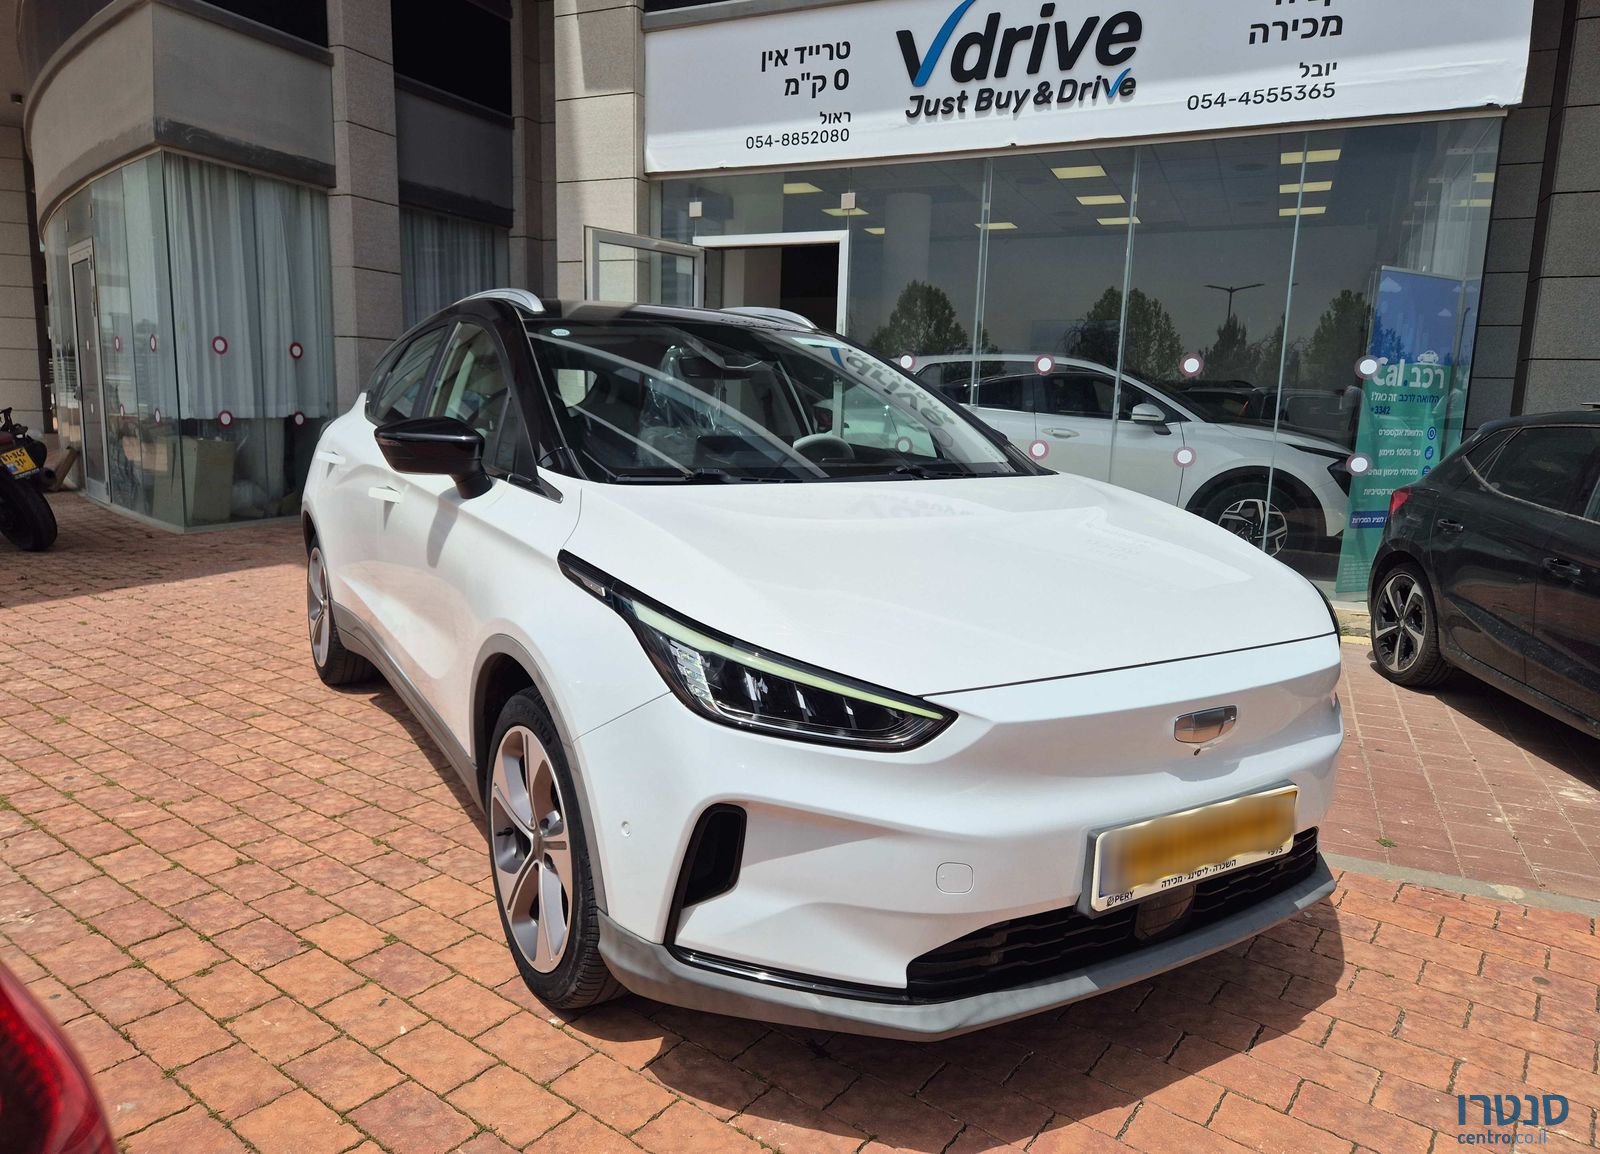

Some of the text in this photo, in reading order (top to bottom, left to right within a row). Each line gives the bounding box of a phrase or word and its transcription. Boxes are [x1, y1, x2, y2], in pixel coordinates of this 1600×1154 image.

[1249, 15, 1343, 45] מכירה
[760, 40, 852, 72] טרייד אין
[896, 0, 1143, 87] Vdrive
[1300, 62, 1338, 79] יובל
[784, 69, 849, 99] 0 ק"מ
[905, 90, 969, 118] Just
[974, 87, 1030, 113] Buy
[1057, 67, 1137, 104] Drive
[1187, 82, 1336, 110] 054-4555365
[819, 110, 852, 125] ראול
[745, 128, 850, 150] 054-8852080
[1409, 366, 1445, 389] רכב
[1212, 859, 1237, 873] השכרה
[1161, 876, 1183, 889] מכירה
